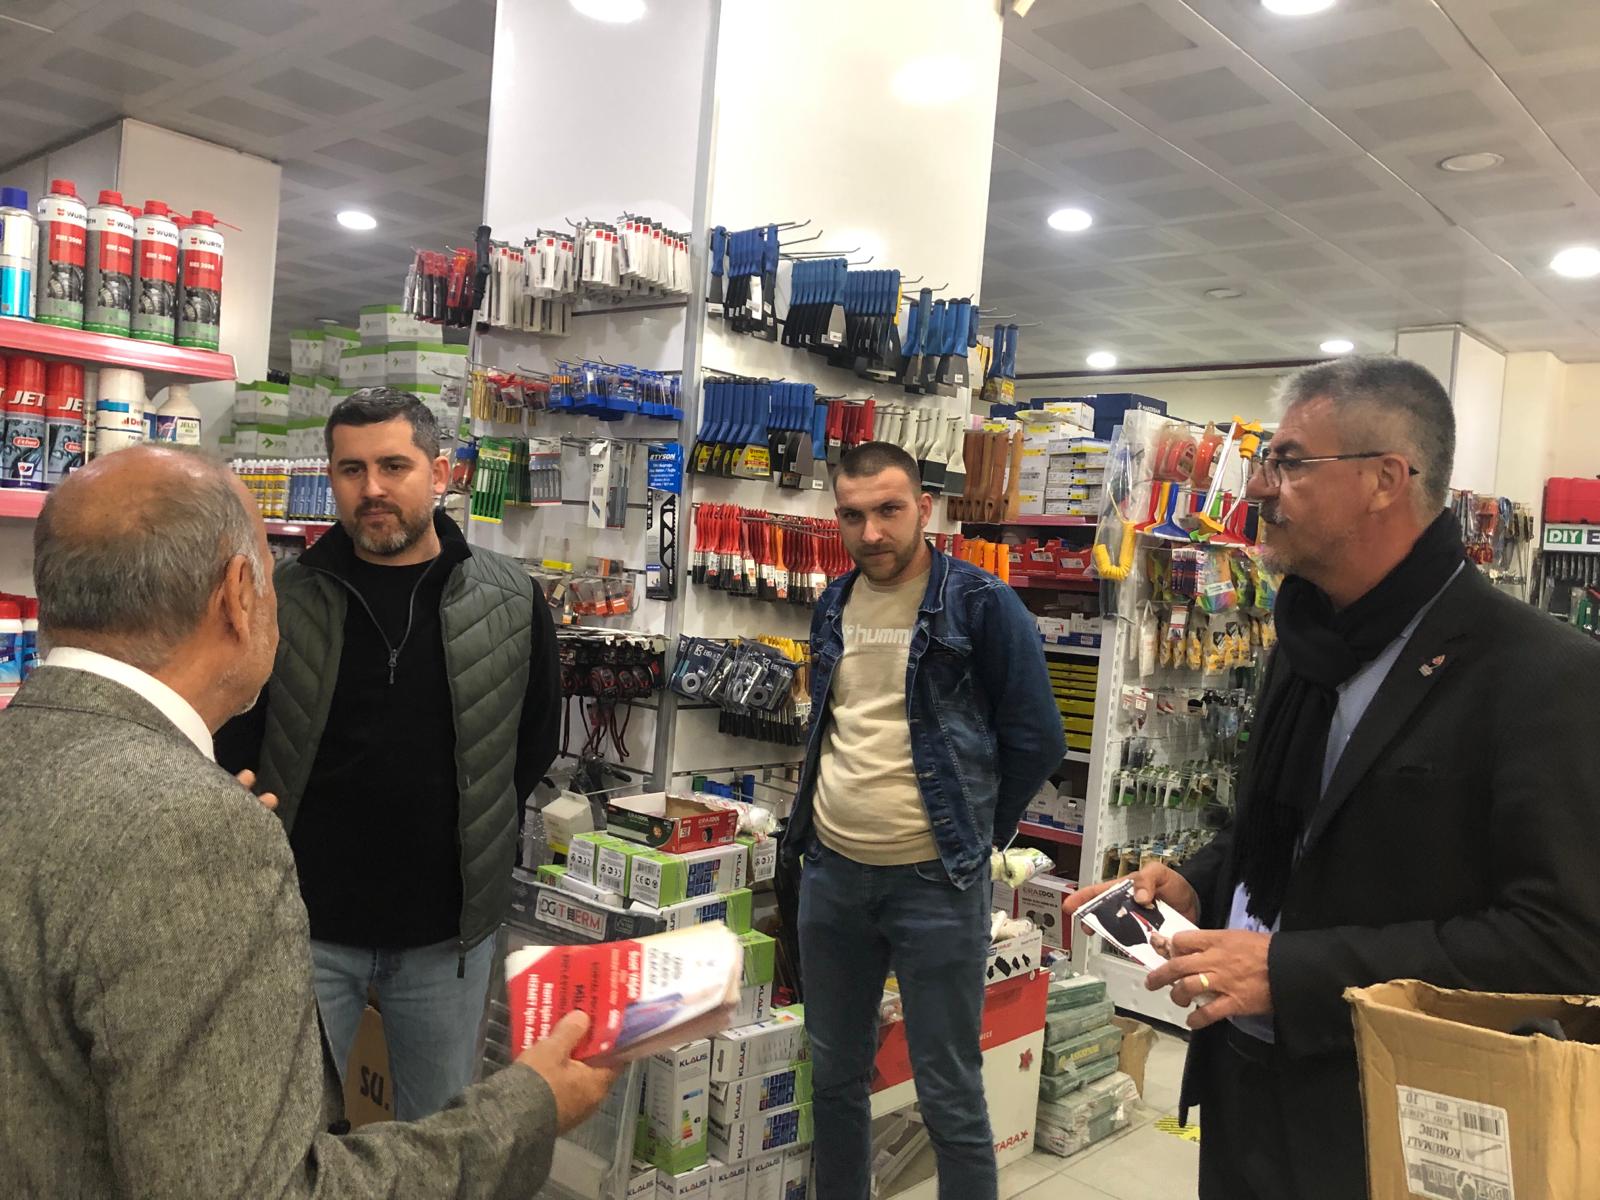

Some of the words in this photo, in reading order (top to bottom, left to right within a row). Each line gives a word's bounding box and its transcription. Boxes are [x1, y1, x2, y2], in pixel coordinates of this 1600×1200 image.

[8, 390, 46, 407] JET
[58, 396, 84, 412] JE
[1549, 530, 1580, 543] DIY
[855, 623, 909, 644] humm
[679, 1052, 708, 1067] KLAUS
[739, 1041, 747, 1077] KLAUS
[734, 1083, 742, 1119] KLAUS
[737, 1123, 745, 1159] KLAUS
[993, 1129, 1029, 1153] TARAX
[756, 1157, 780, 1172] KLAUS
[718, 1166, 745, 1182] KLAUS
[627, 1180, 654, 1196] KLAUS
[656, 1175, 674, 1193] LAUS
[680, 1178, 707, 1195] KLAUS
